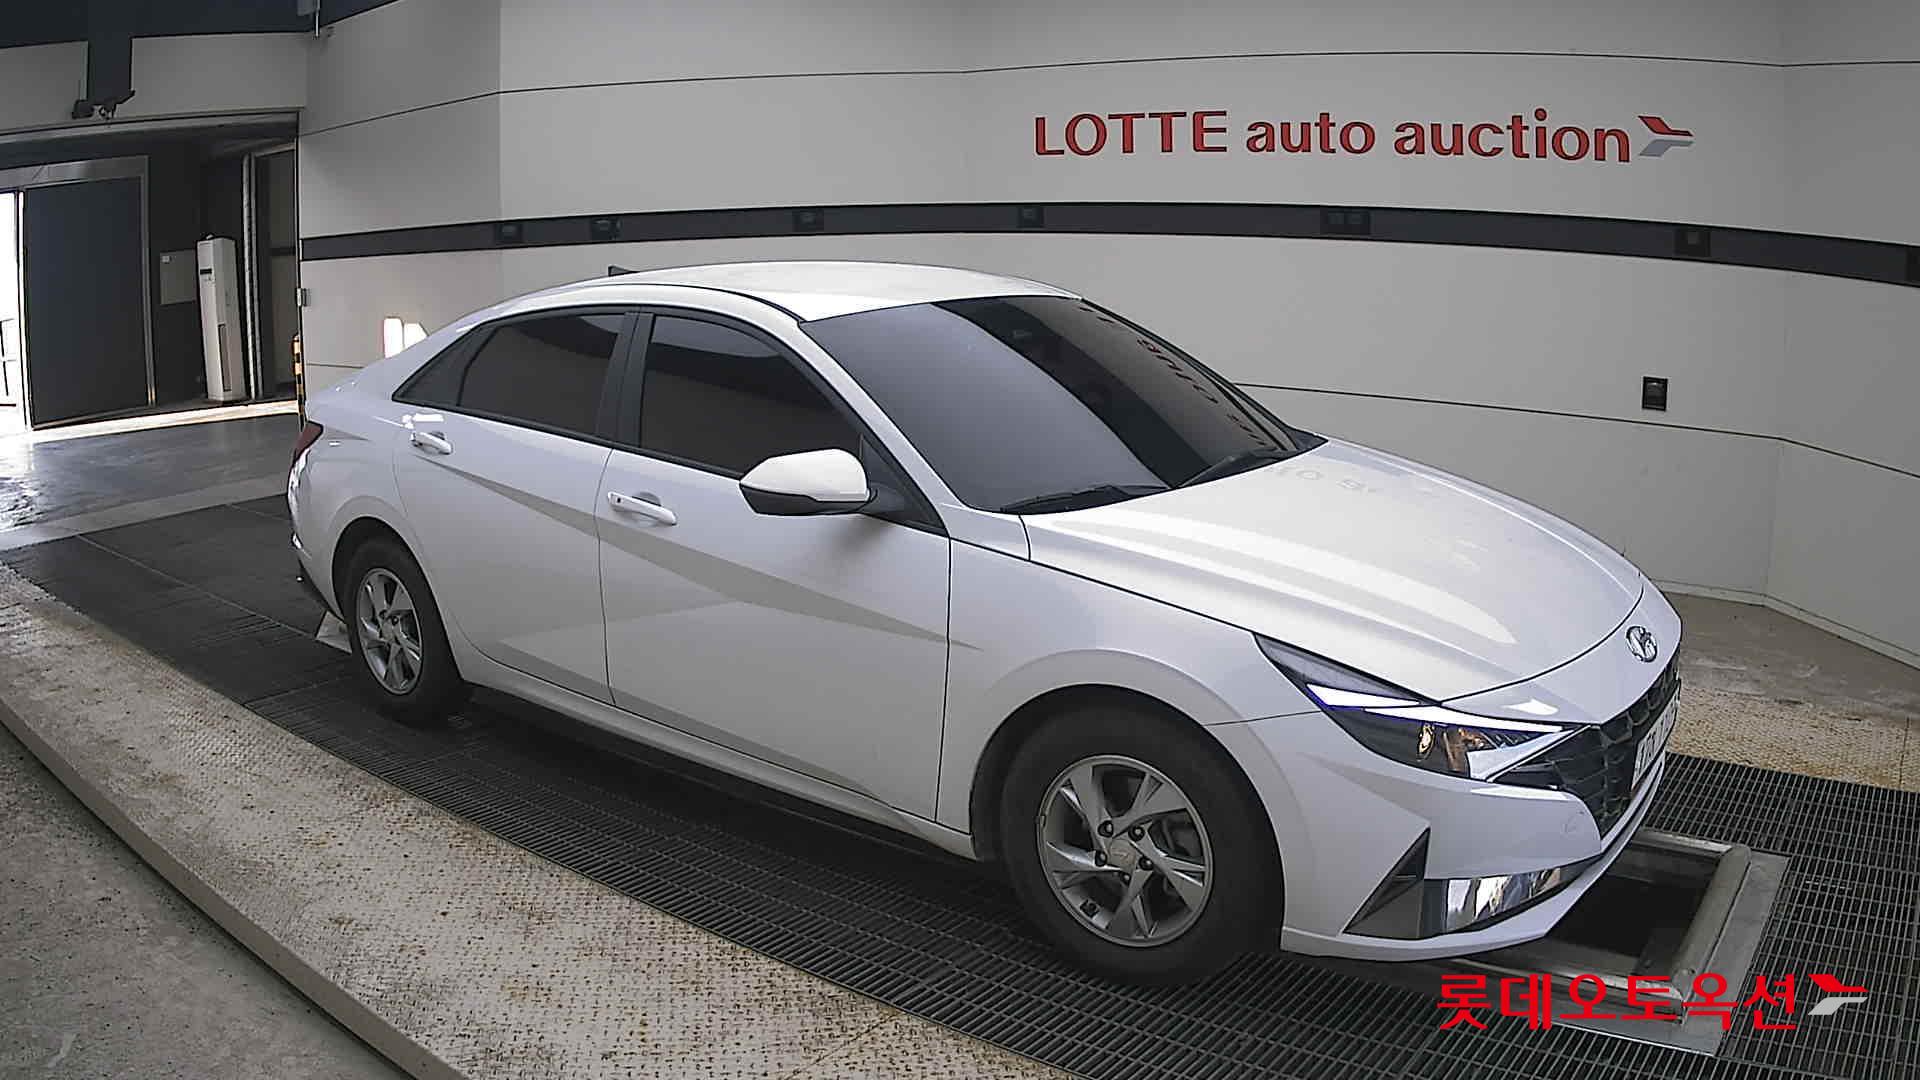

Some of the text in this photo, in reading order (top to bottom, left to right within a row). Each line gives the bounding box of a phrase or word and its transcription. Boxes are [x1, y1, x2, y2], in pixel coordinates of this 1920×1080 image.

[1034, 108, 1631, 163] LOTTE auto auction
